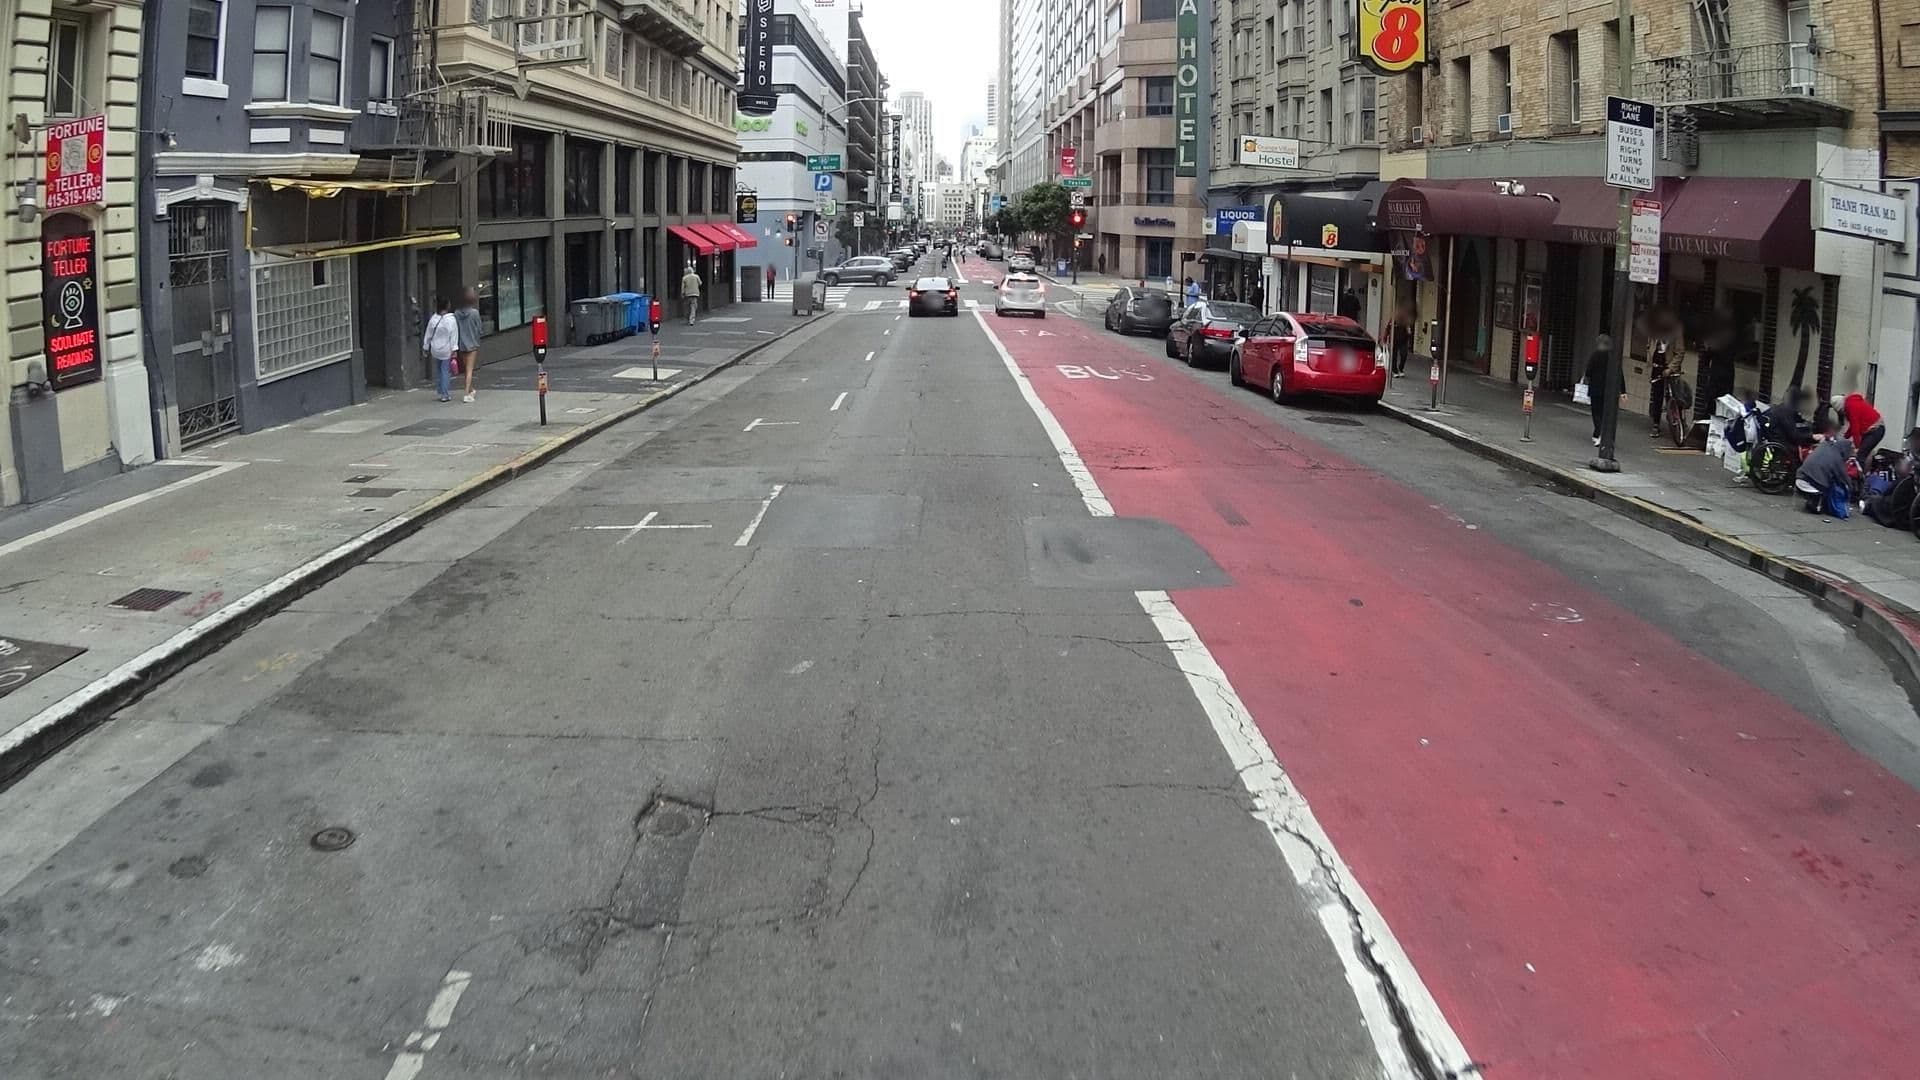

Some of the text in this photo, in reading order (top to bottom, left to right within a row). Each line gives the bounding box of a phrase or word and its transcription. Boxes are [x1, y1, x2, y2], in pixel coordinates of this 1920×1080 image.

[1372, 6, 1422, 63] 8
[758, 17, 768, 86] SPERO
[1177, 37, 1198, 167] HOTEL
[1621, 102, 1642, 114] RIGHT
[1621, 111, 1641, 122] LANE
[48, 117, 104, 141] FORTUNE
[1618, 125, 1643, 137] BUSES
[1617, 134, 1637, 145] TAXIS
[1619, 145, 1641, 156] RIGHT
[1258, 154, 1296, 166] Hostel
[1619, 155, 1643, 166] TURNS
[1620, 165, 1641, 175] ONLY
[55, 173, 94, 193] TELLER
[817, 174, 831, 190] P
[1609, 173, 1650, 186] AT ALL TIMES
[47, 186, 102, 208] 415-319-1495
[1831, 197, 1858, 213] THANH
[1219, 210, 1256, 220] LIQUOR
[1326, 233, 1337, 245] 8
[1572, 228, 1589, 242] BAR
[47, 236, 92, 258] FORTUNE
[1668, 236, 1732, 257] LIVE MUSIC
[53, 257, 88, 277] TELLER
[51, 329, 95, 352] SOULMATE
[56, 348, 94, 370] READINGS
